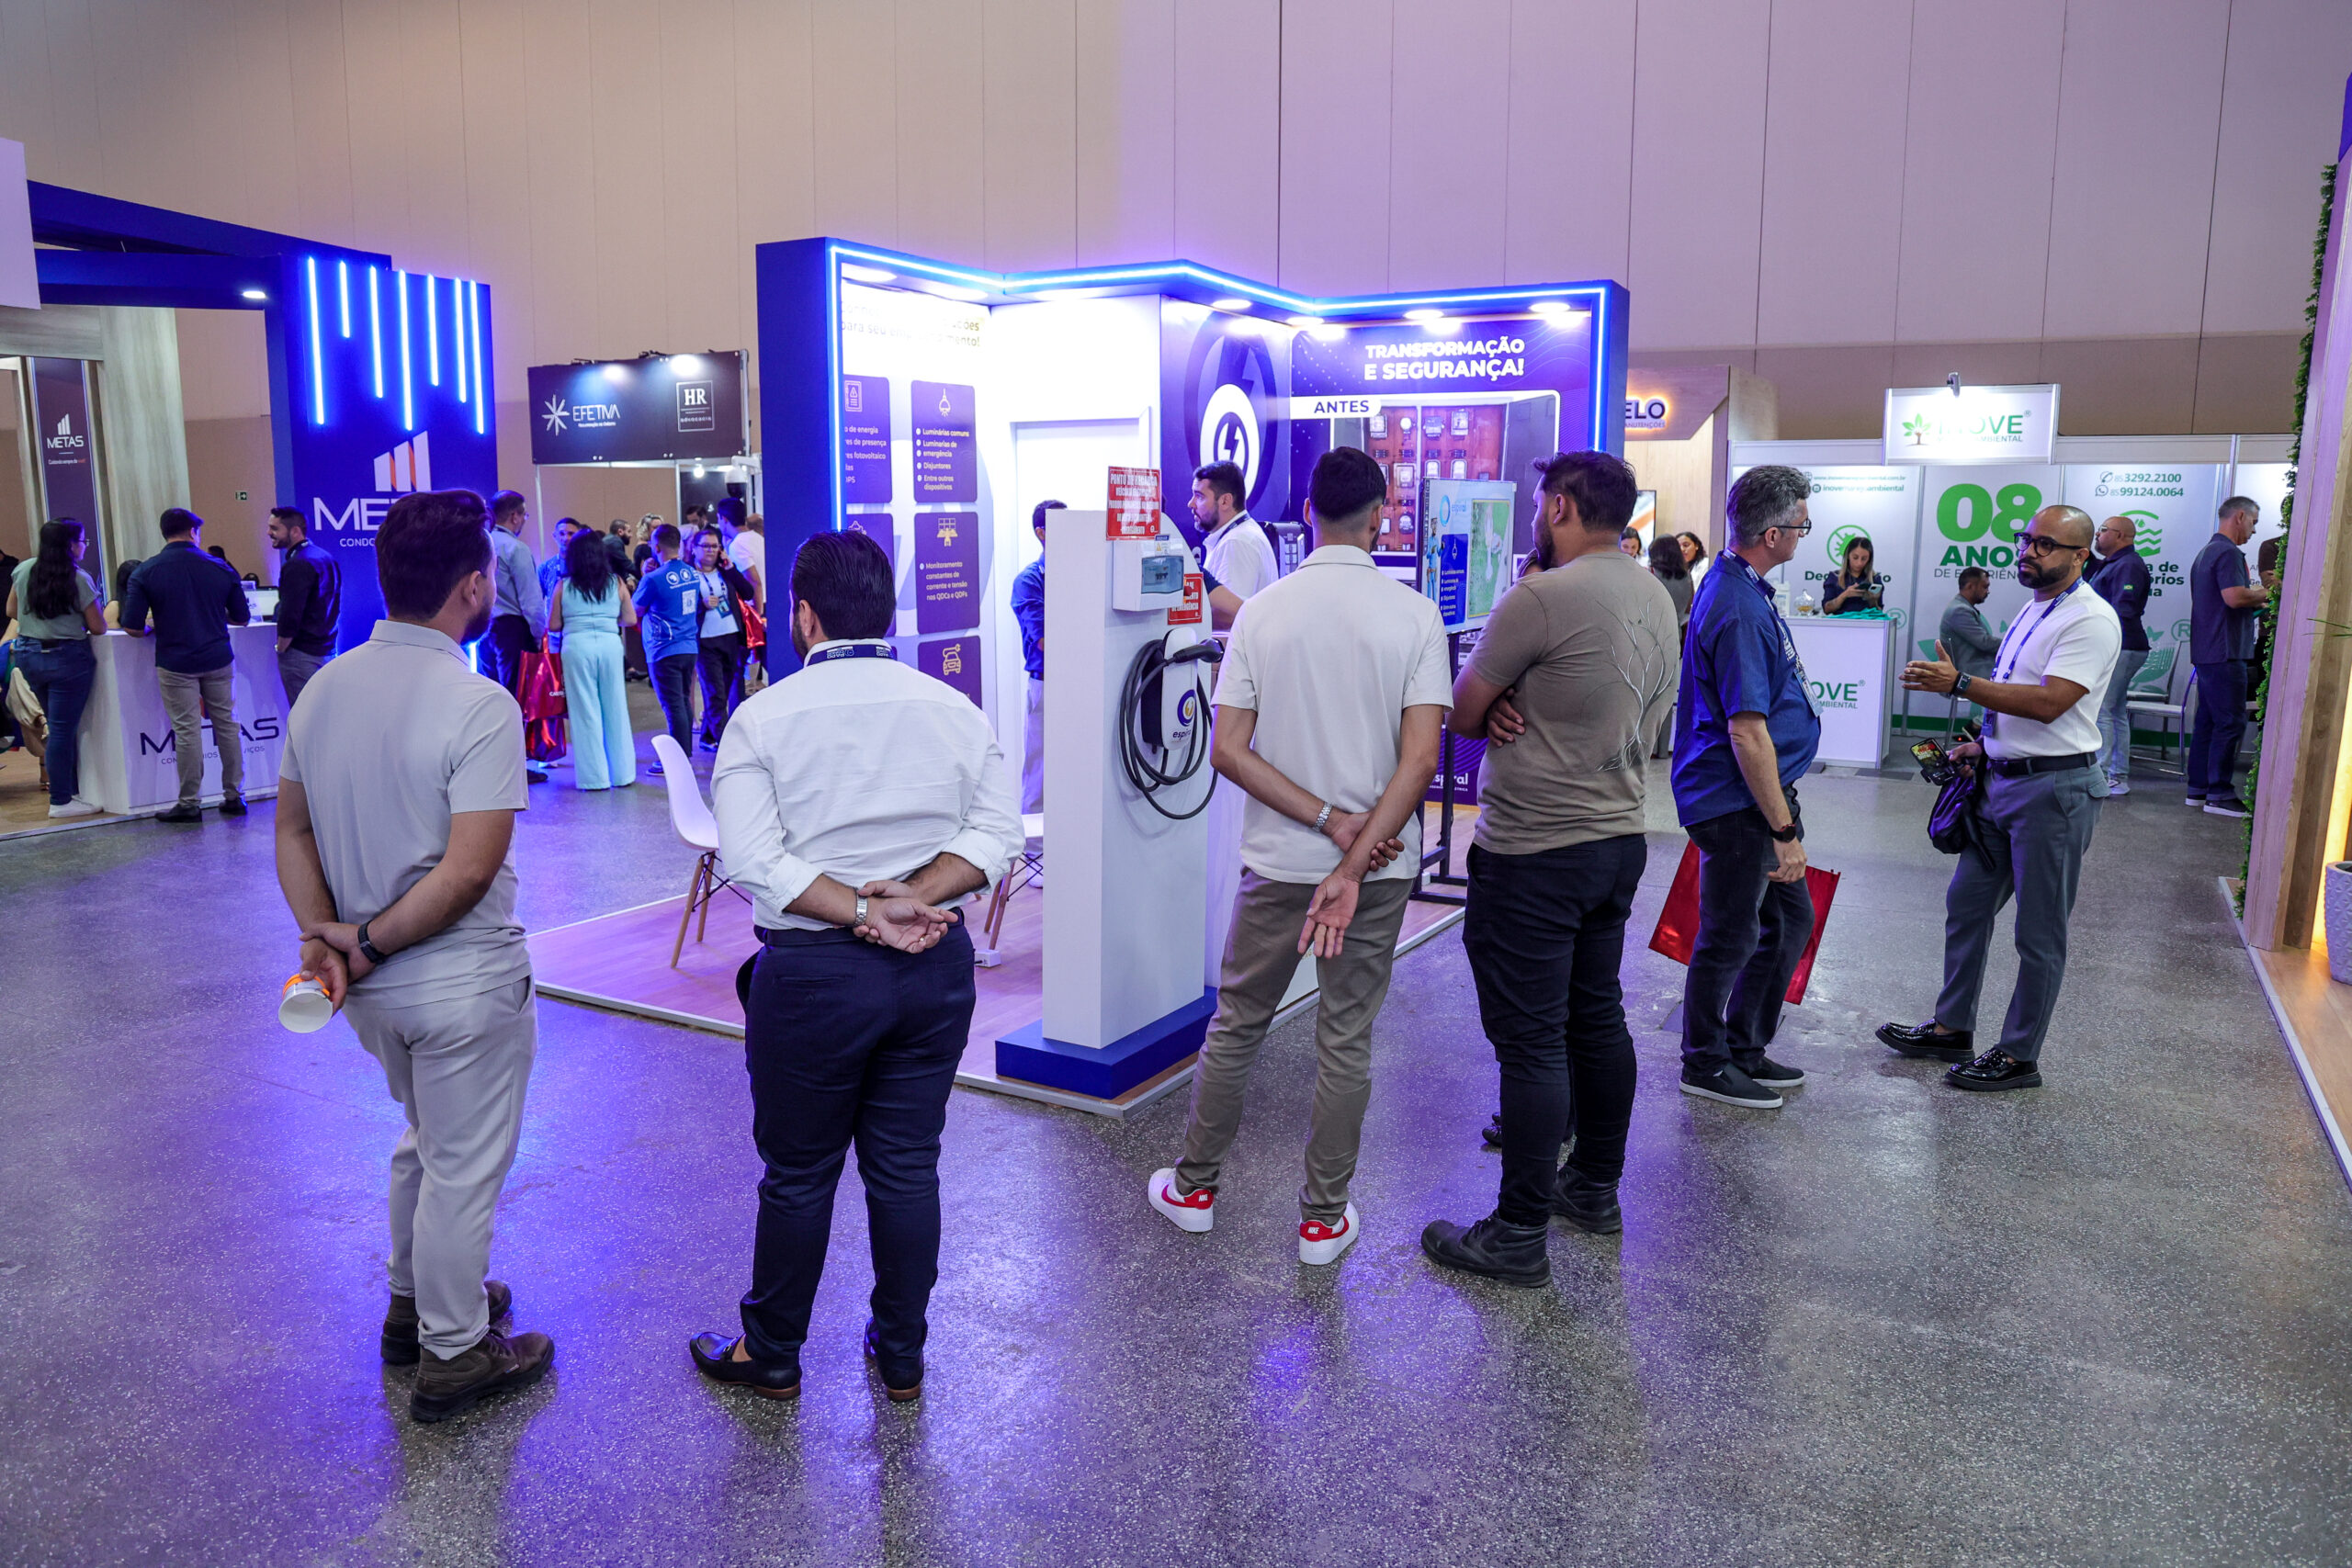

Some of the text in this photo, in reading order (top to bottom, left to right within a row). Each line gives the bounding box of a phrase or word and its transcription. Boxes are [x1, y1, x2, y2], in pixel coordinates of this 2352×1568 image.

[1365, 336, 1525, 358] TRANSFORMAÇÃO
[1364, 358, 1525, 381] E SEGURANÇA!
[684, 388, 707, 405] HR
[572, 403, 621, 422] EFETIVA
[1314, 400, 1370, 413] ANTES
[47, 435, 85, 448] METAS
[2124, 473, 2182, 483] 3292.2100
[2120, 487, 2184, 497] 99124.0064
[1937, 483, 2042, 543] 08
[1939, 546, 2019, 568] ANO
[1934, 569, 1951, 578] DE
[2159, 561, 2178, 573] de
[1810, 682, 1858, 701] OVE
[1818, 701, 1858, 709] MBIENTAL
